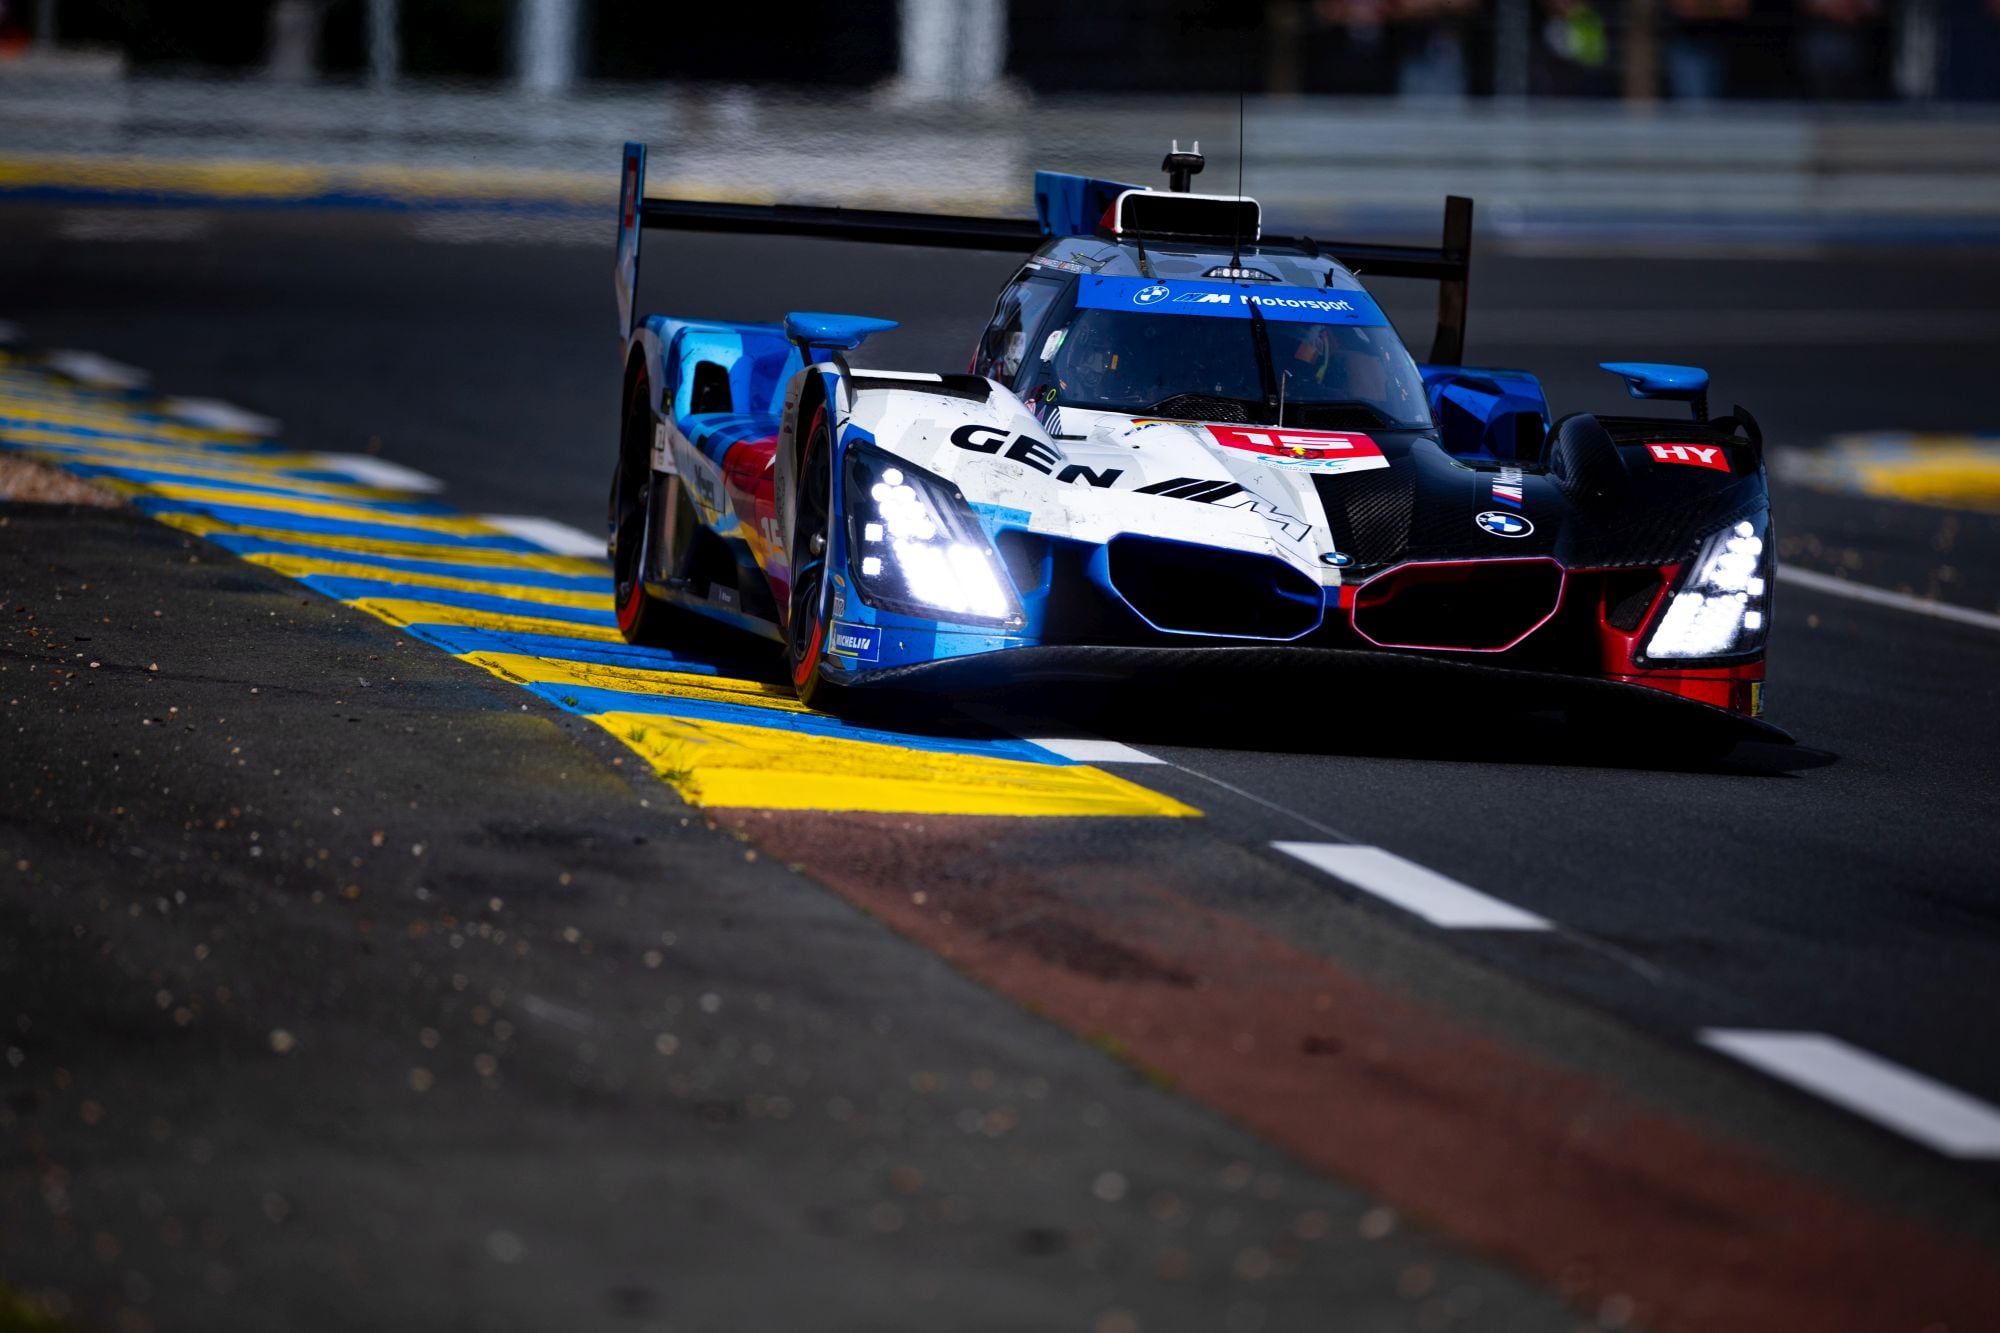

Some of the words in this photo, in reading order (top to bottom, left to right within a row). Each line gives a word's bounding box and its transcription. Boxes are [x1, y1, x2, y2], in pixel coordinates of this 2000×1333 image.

[1239, 295, 1355, 311] Motorsport
[1231, 431, 1355, 450] 15
[1650, 445, 1720, 465] HY
